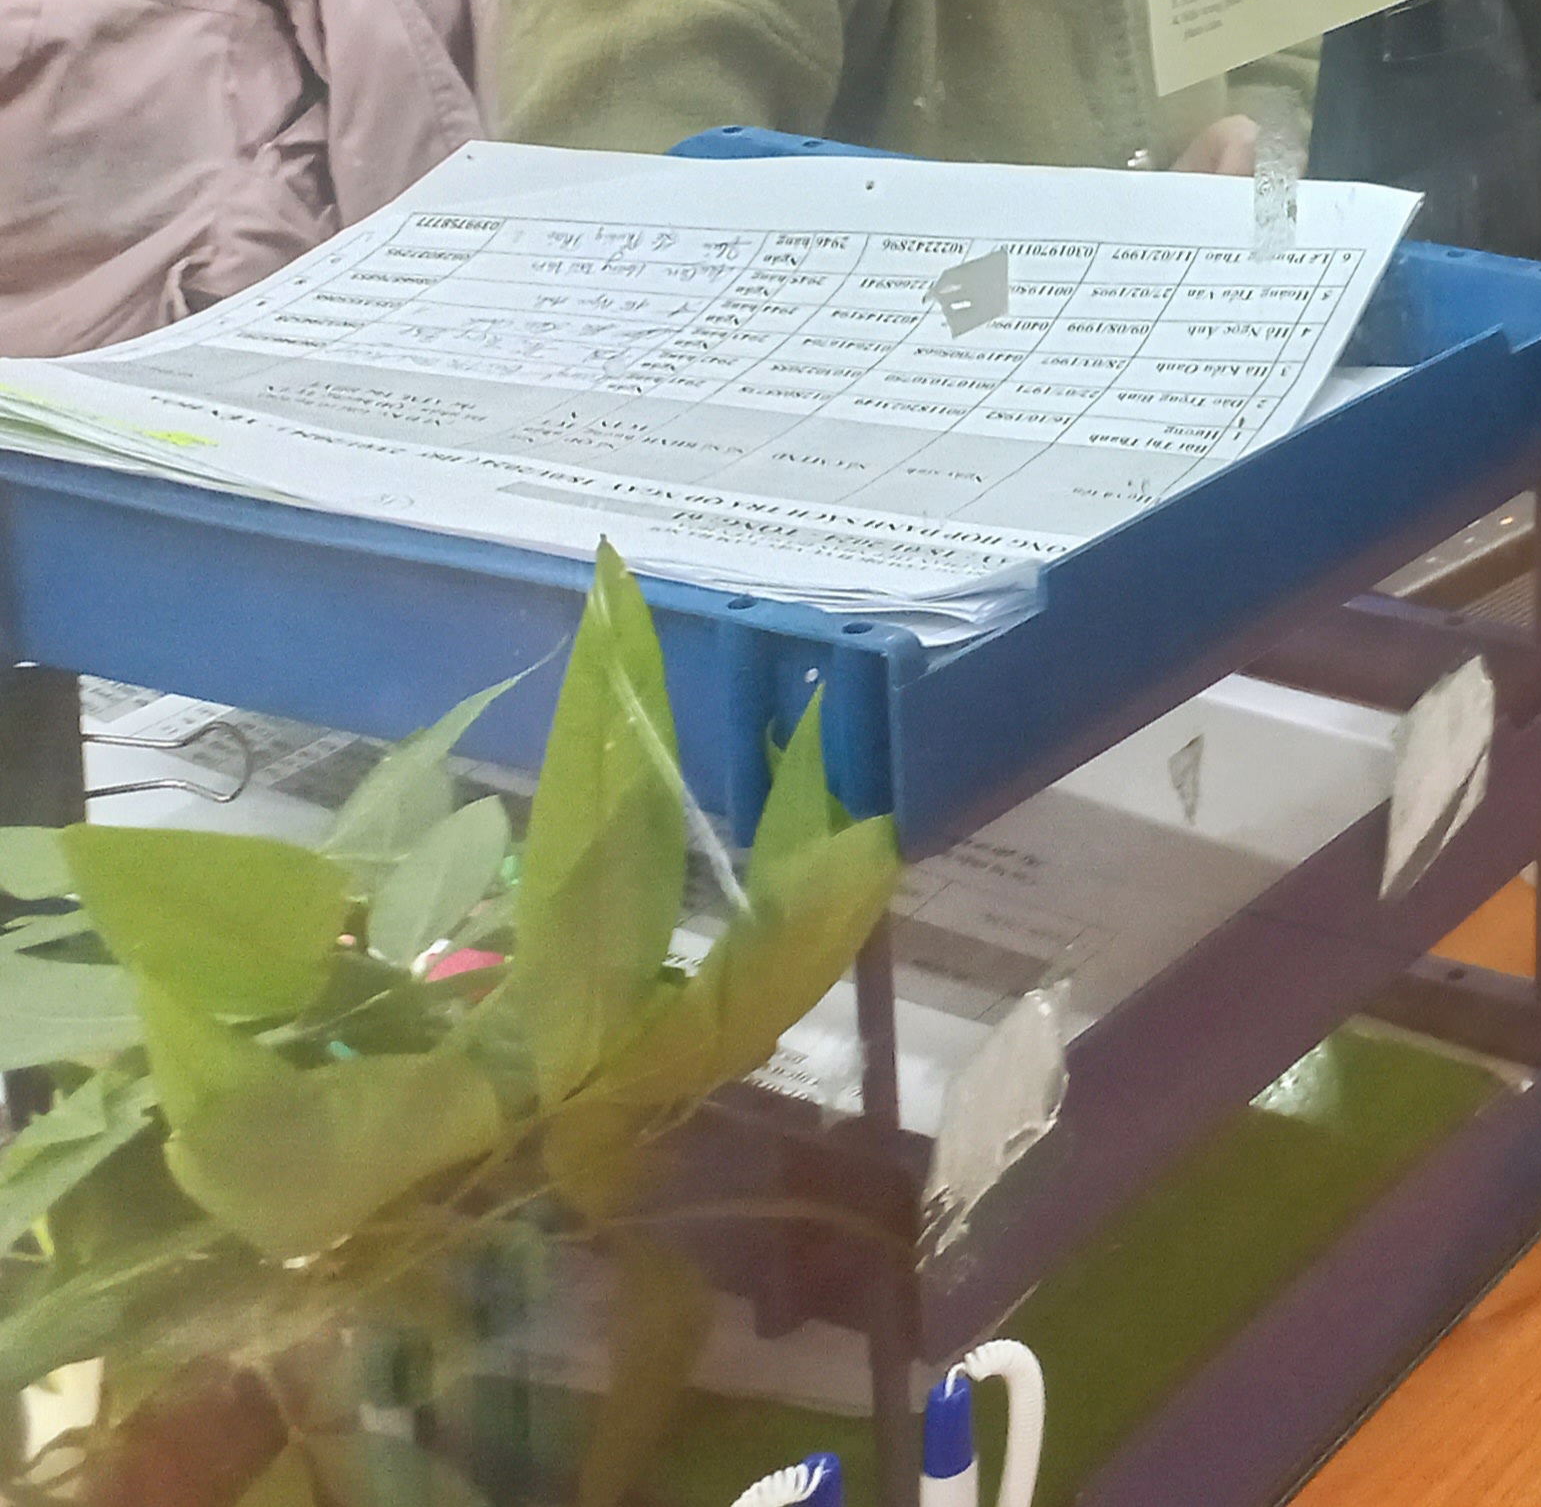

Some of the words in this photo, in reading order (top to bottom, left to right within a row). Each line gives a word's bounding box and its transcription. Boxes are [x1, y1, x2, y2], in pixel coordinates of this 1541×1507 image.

[815, 235, 848, 249] 2946
[1111, 249, 1193, 263] 11/02/1997
[1342, 252, 1352, 263] 6
[1320, 289, 1333, 301] 5
[1066, 322, 1150, 337] 09/08/1999
[1300, 327, 1312, 338] 4
[1280, 365, 1292, 377] 3
[1256, 399, 1268, 409] 2
